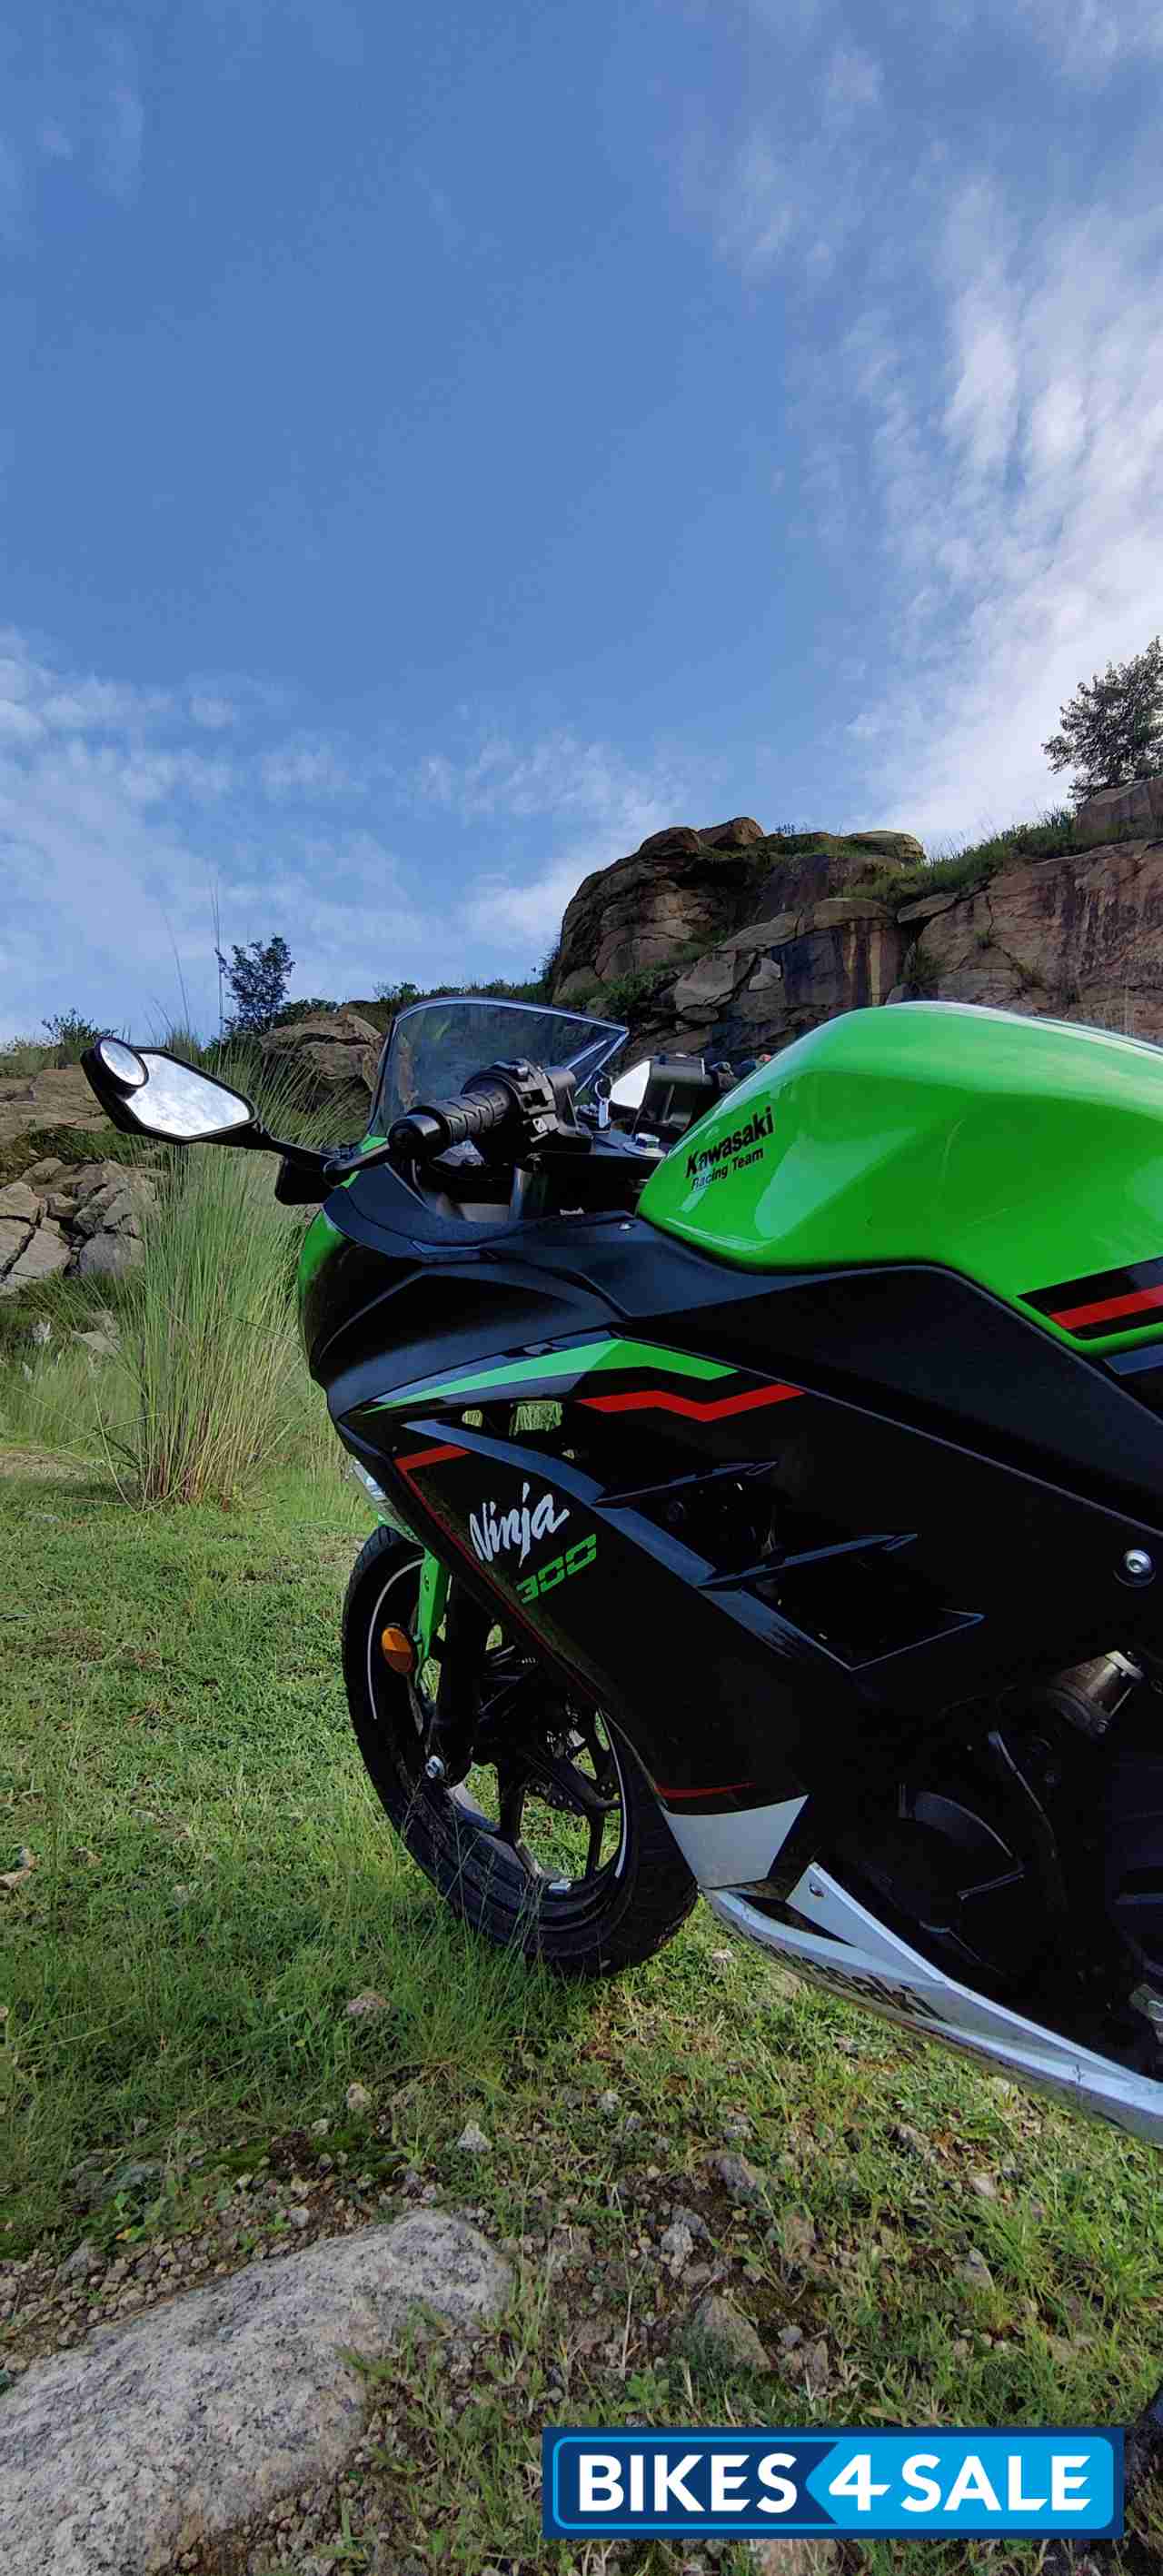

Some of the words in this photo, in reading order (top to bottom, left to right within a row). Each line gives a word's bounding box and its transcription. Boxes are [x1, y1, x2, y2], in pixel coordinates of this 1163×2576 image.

[685, 1105, 774, 1179] Kawasaki
[691, 1165, 728, 1191] Racing
[732, 1148, 764, 1171] Team
[469, 1481, 571, 1568] Ninja
[515, 1533, 597, 1605] 300
